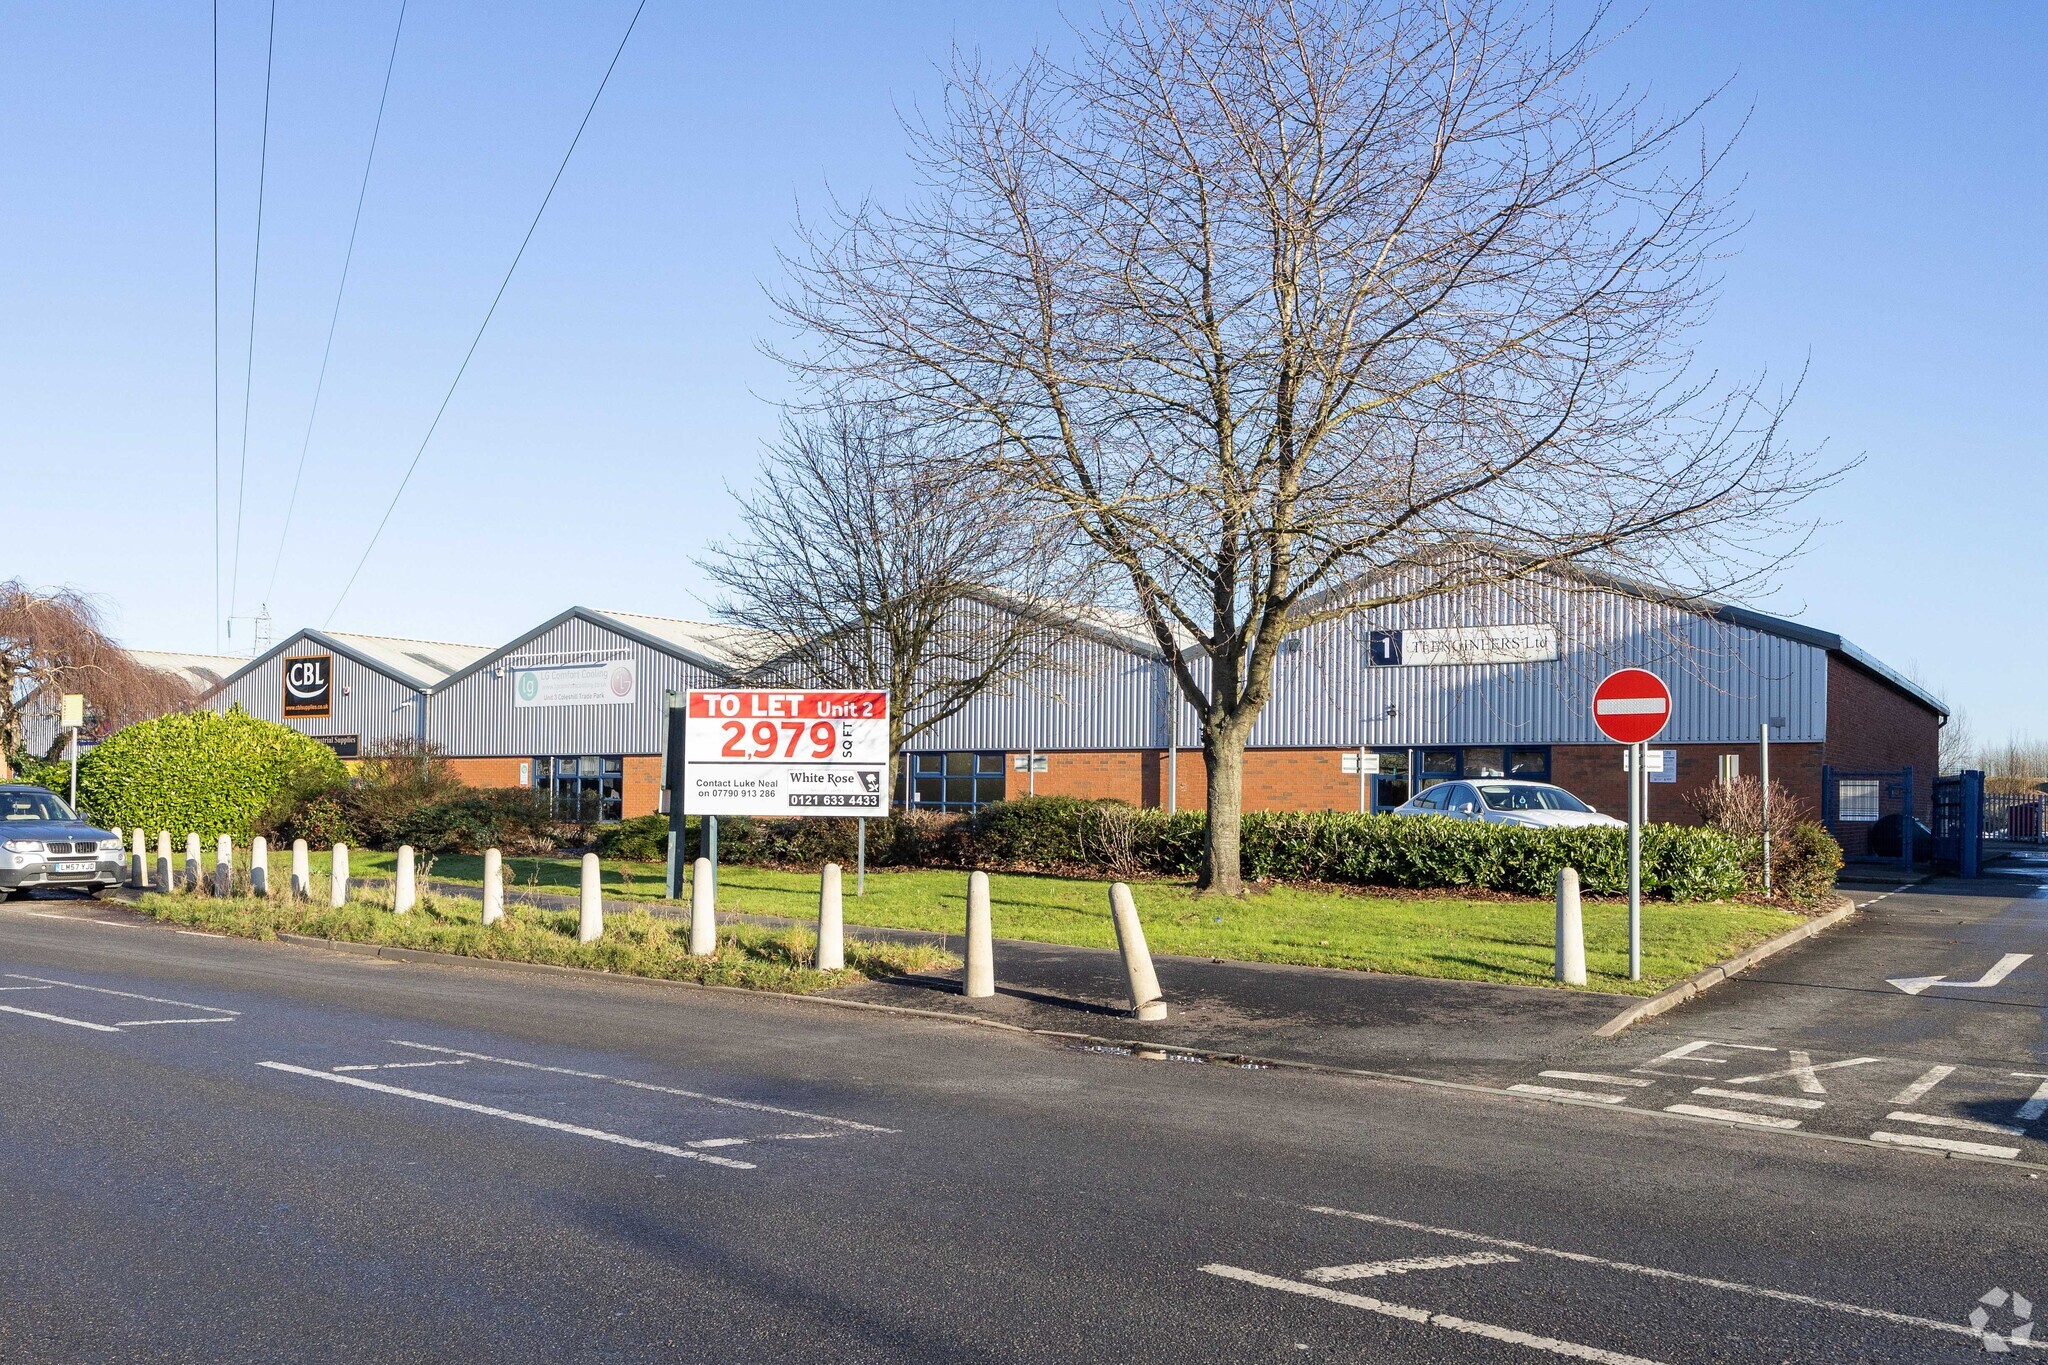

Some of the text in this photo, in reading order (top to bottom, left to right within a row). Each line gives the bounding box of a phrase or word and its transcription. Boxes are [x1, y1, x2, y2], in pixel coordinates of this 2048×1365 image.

[1382, 637, 1390, 659] 1
[290, 662, 325, 686] CBL
[540, 669, 608, 681] LG Comfort Cooling
[558, 693, 578, 701] Coleshill
[703, 694, 873, 718] TO LET Unit 2
[334, 736, 356, 745] Supplies
[721, 720, 837, 761] 2,979
[842, 722, 853, 759] SQ FT
[696, 779, 778, 787] Contact Luke Neal
[790, 772, 855, 787] White Rose
[712, 789, 739, 797] 07790
[741, 789, 757, 797] 913
[760, 789, 776, 797] 286
[791, 795, 877, 806] 0121 633 4433
